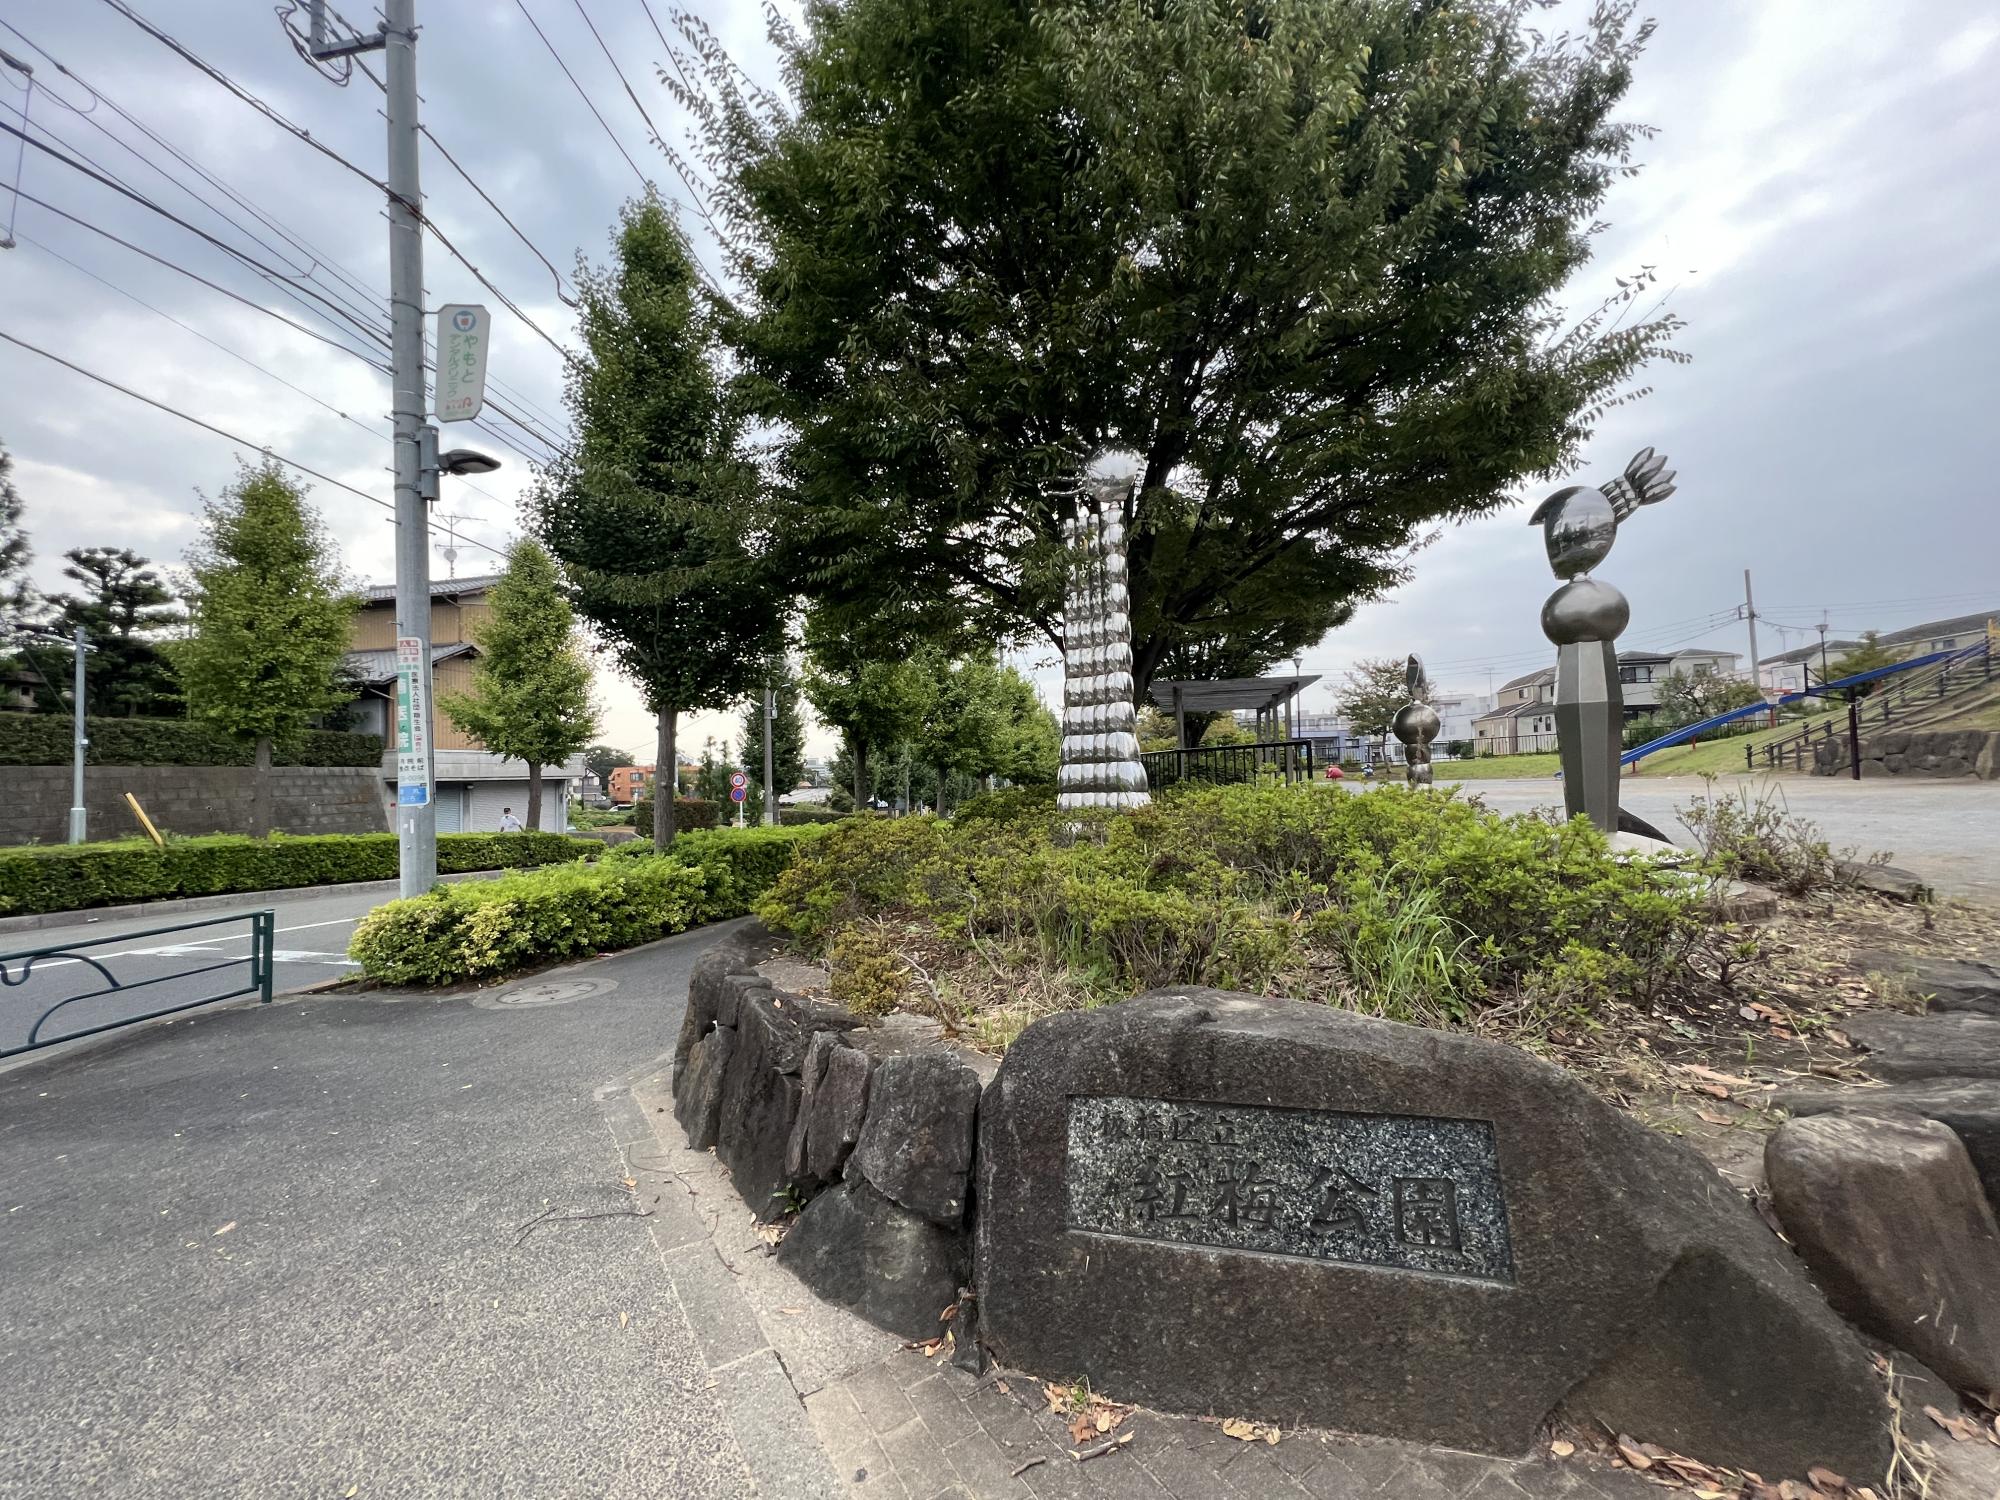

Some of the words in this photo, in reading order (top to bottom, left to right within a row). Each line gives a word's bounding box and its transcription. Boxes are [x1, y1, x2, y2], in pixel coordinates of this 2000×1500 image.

[1100, 1109, 1240, 1147] 板橋区立
[1134, 1155, 1464, 1256] 紅梅公園
